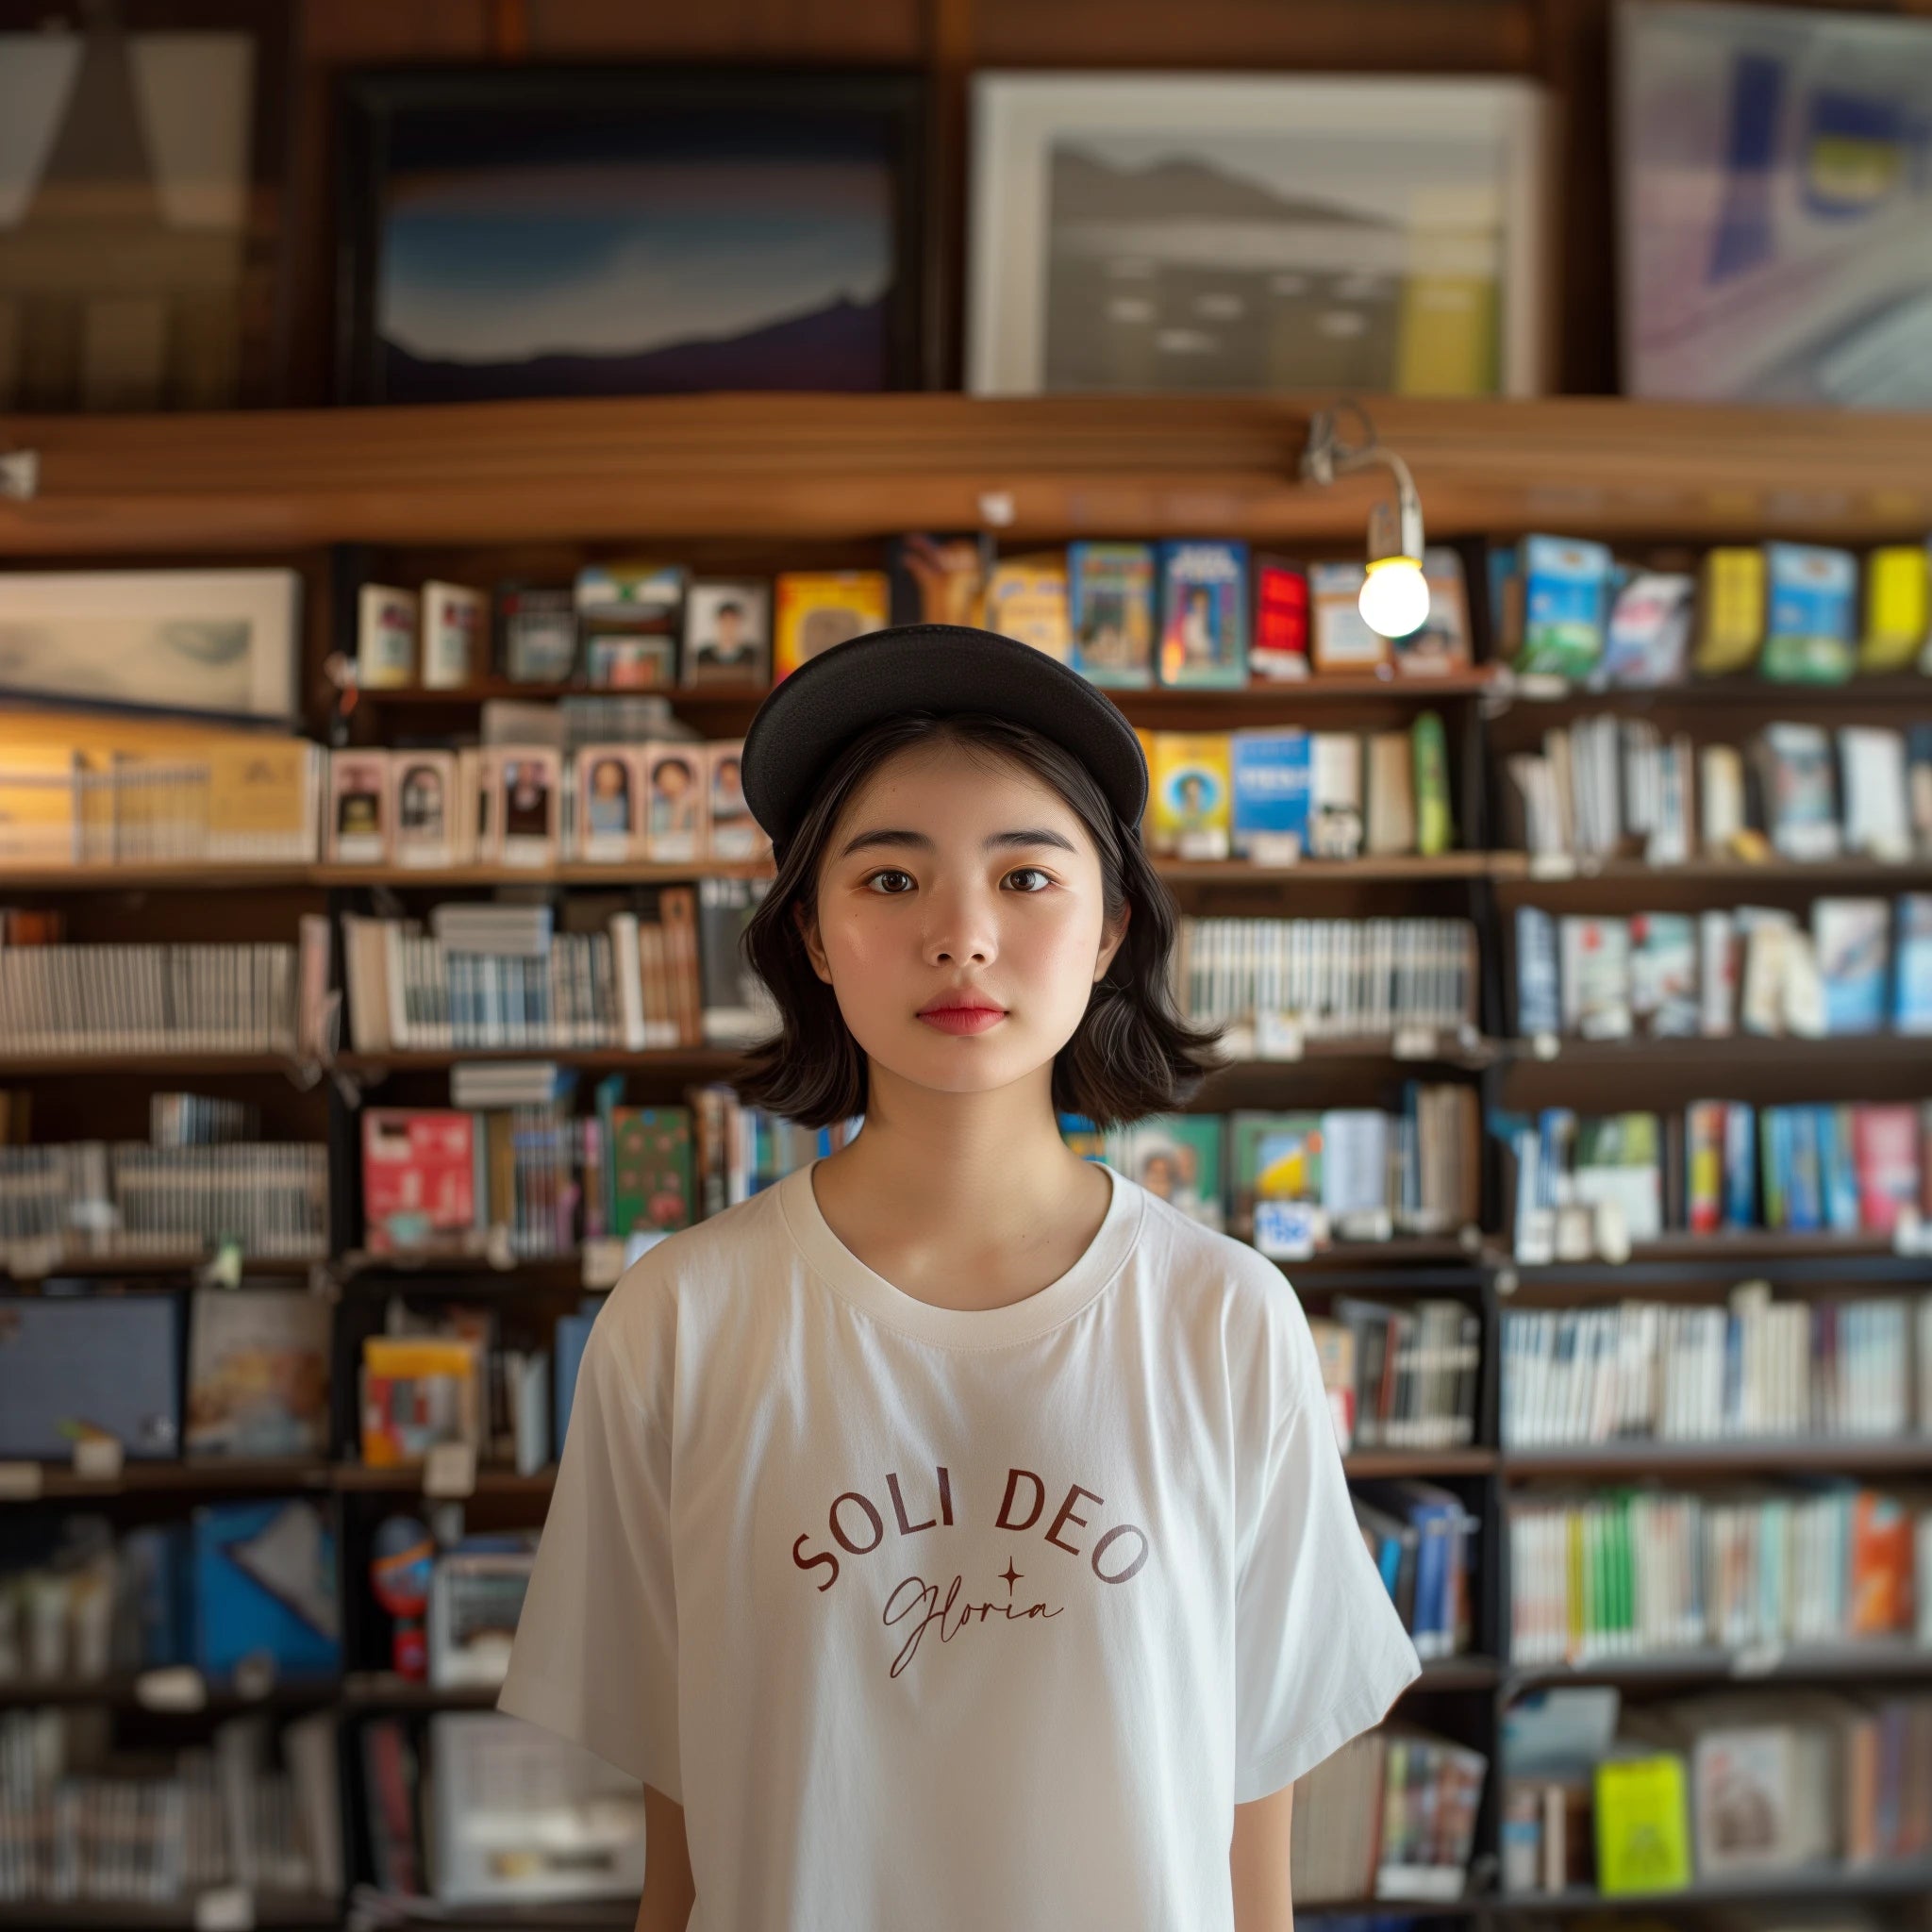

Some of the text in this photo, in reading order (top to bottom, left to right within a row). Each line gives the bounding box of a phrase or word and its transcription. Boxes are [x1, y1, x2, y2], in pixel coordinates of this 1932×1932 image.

[792, 1466, 1149, 1592] SOLI DEO
[883, 1575, 1064, 1678] Gloria
